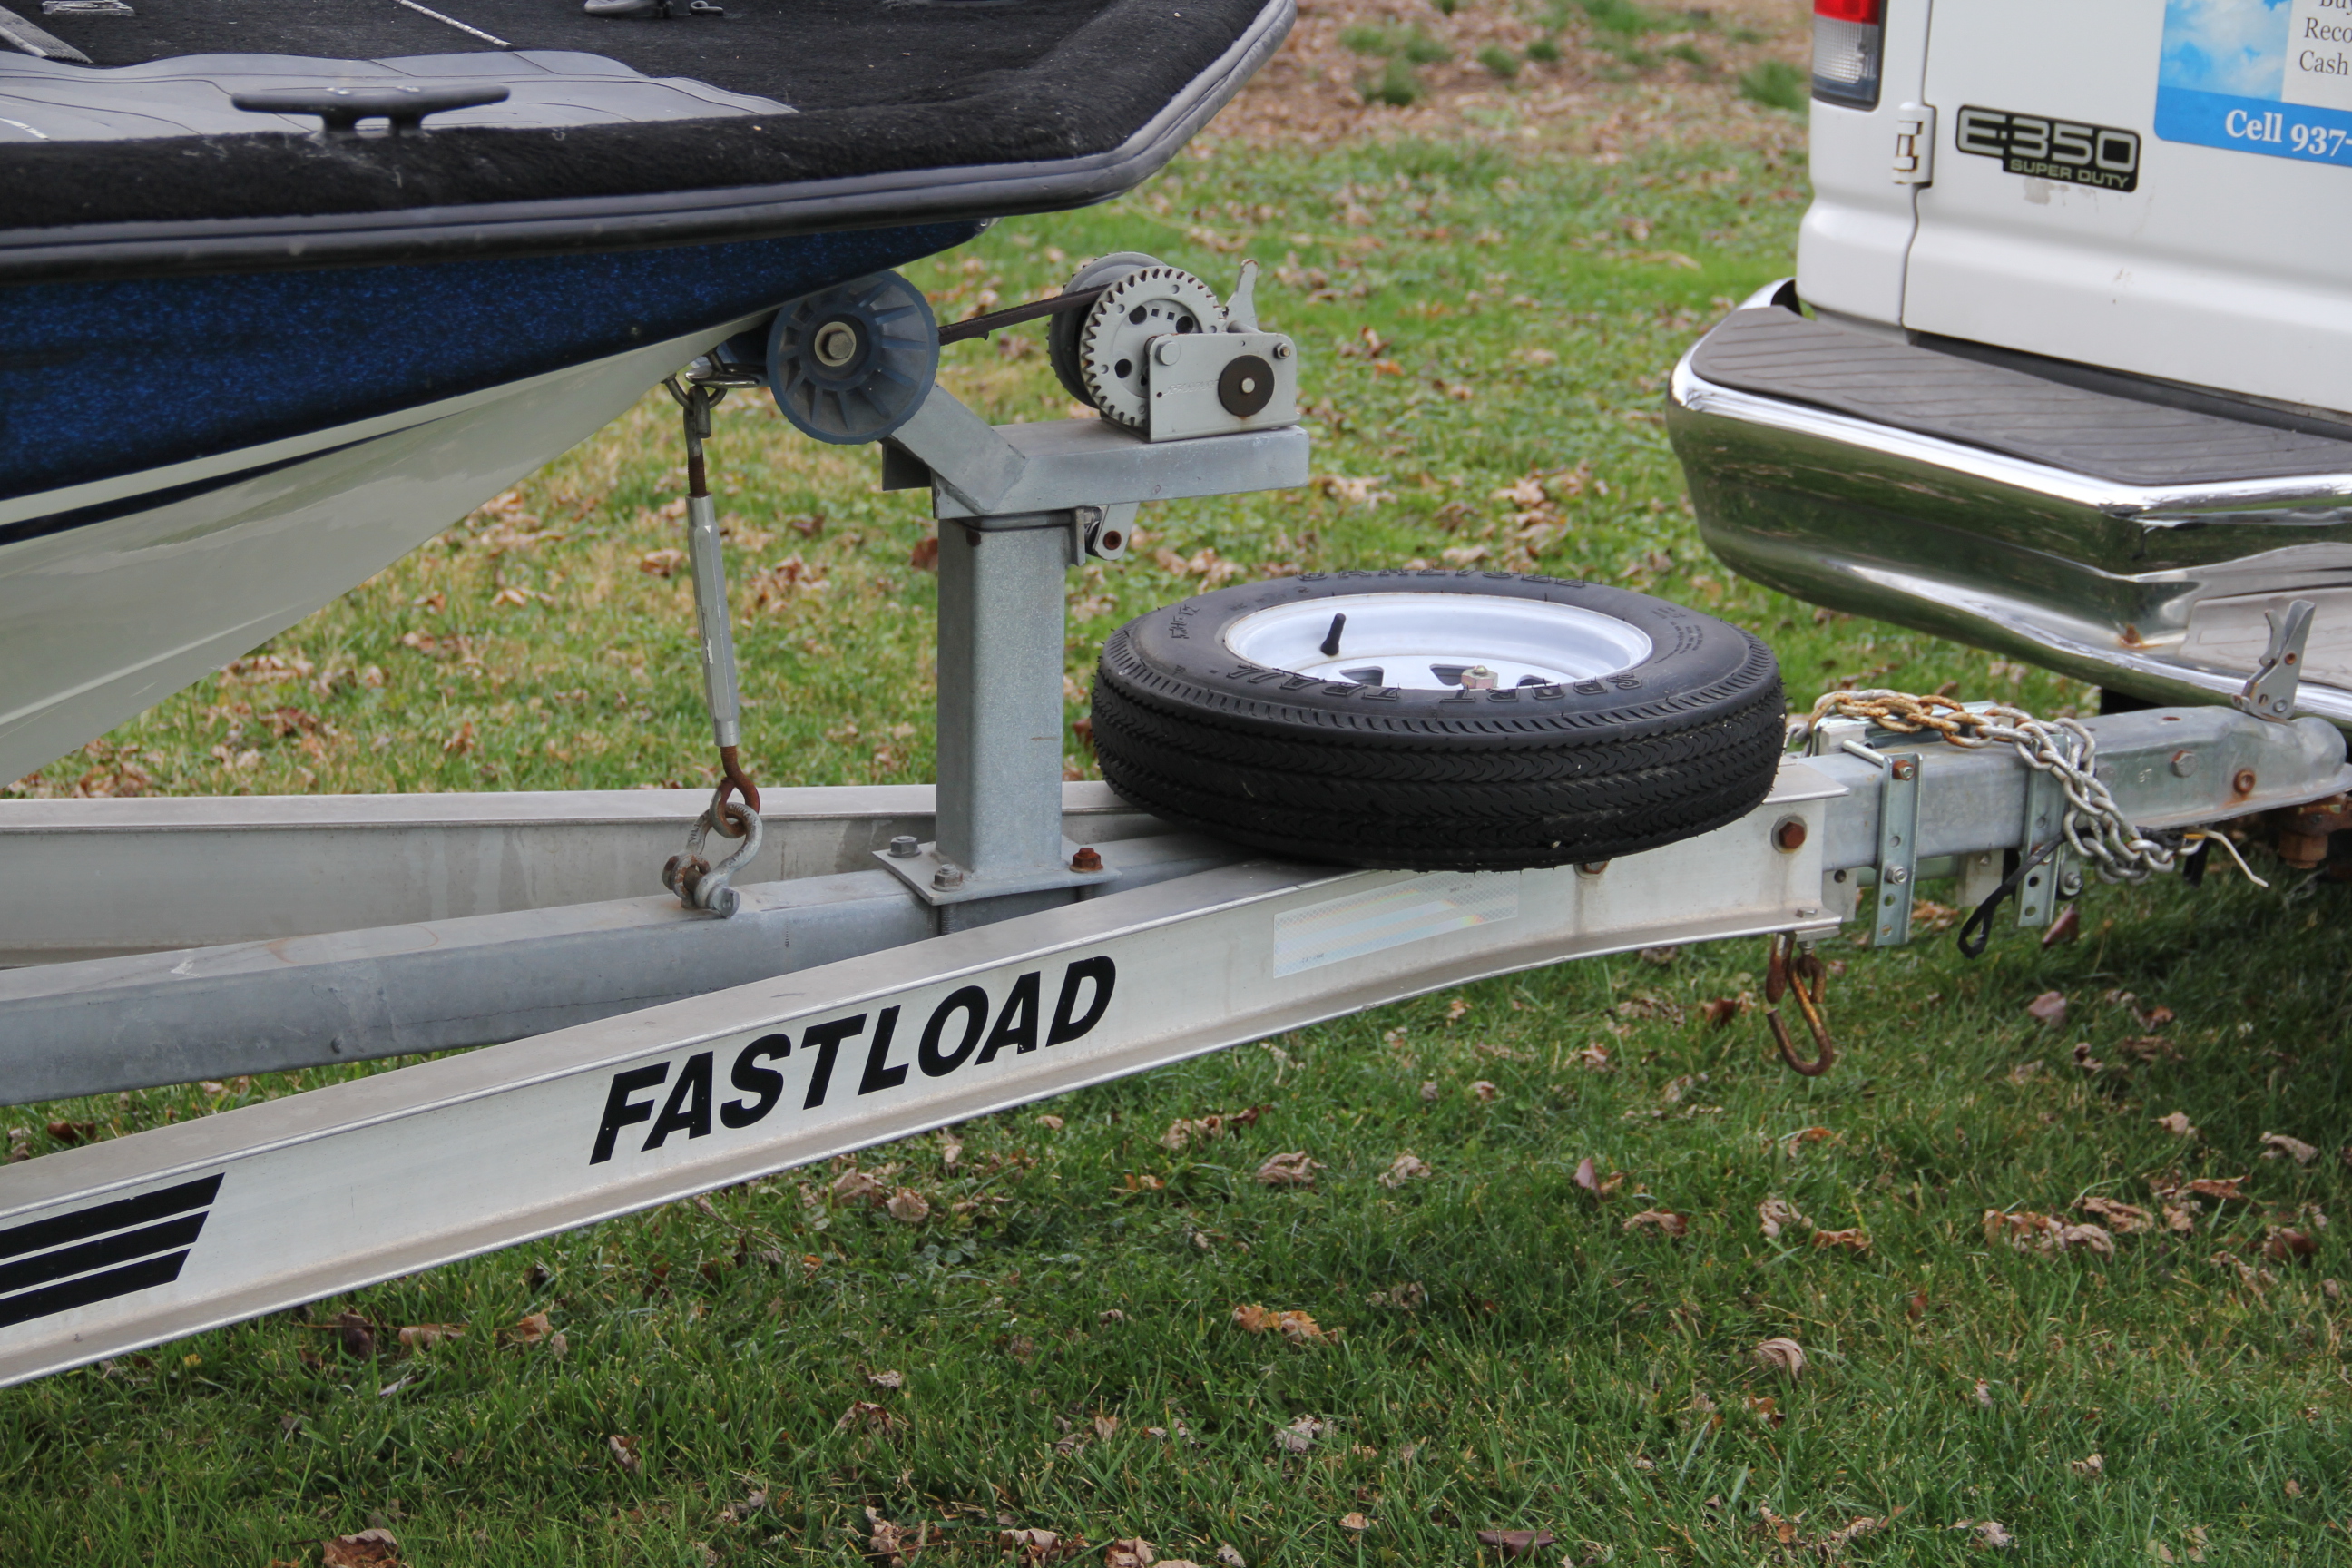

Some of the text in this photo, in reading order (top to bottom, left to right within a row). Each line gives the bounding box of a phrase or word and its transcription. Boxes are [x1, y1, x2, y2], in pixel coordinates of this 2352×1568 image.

[2299, 49, 2348, 76] Cash
[2225, 109, 2283, 143] Cell
[2010, 159, 2130, 189] SUPER DUTY
[1226, 663, 1643, 703] SPORT TRAIL
[590, 956, 1117, 1165] FASTLOAD
